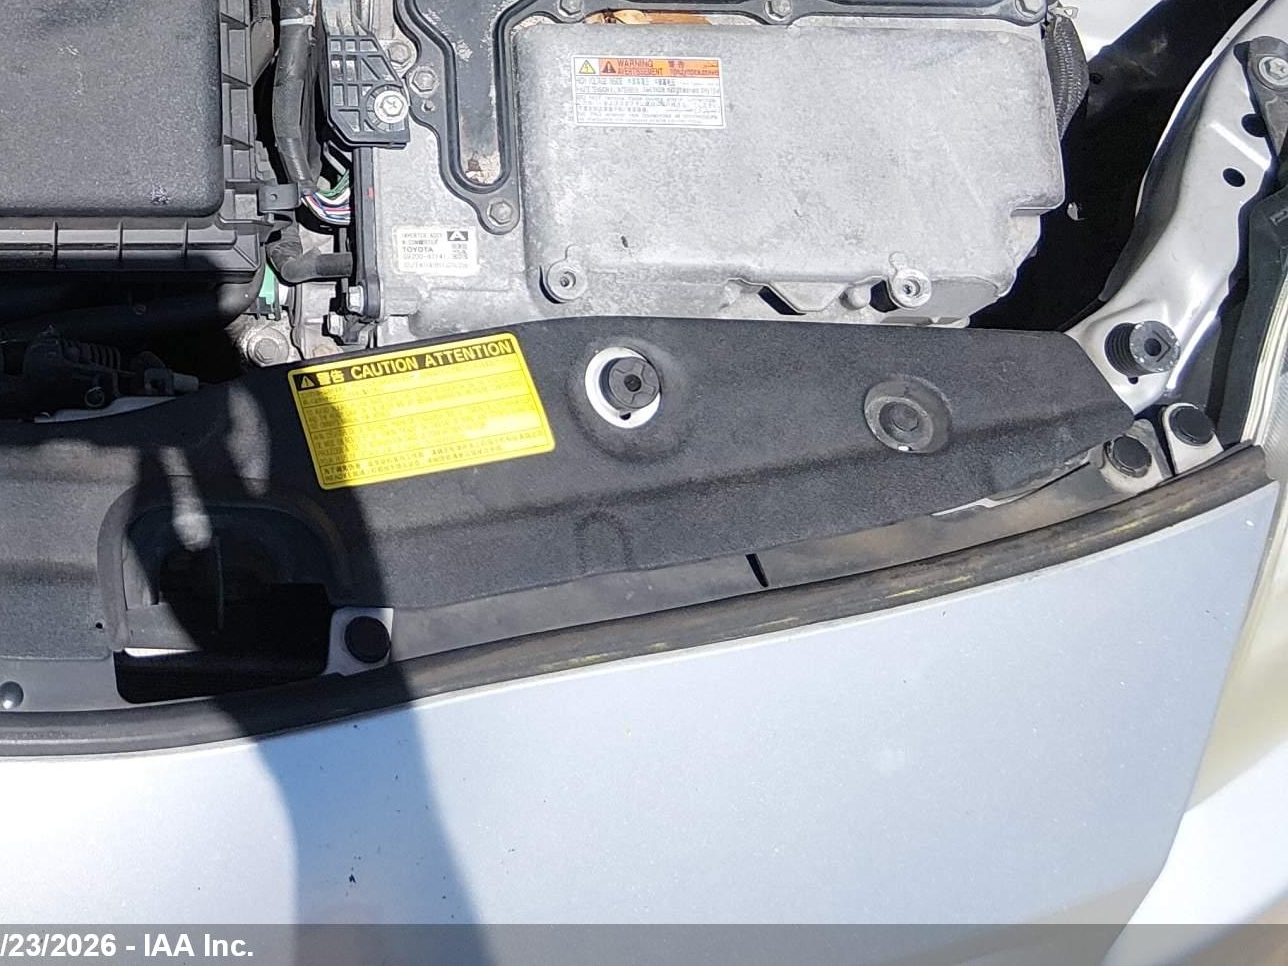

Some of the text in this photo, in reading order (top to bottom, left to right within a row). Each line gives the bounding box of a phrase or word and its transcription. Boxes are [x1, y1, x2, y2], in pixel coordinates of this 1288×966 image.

[617, 58, 653, 68] WARNING
[350, 356, 419, 380] CAUTION
[424, 339, 513, 368] ATTENTION
